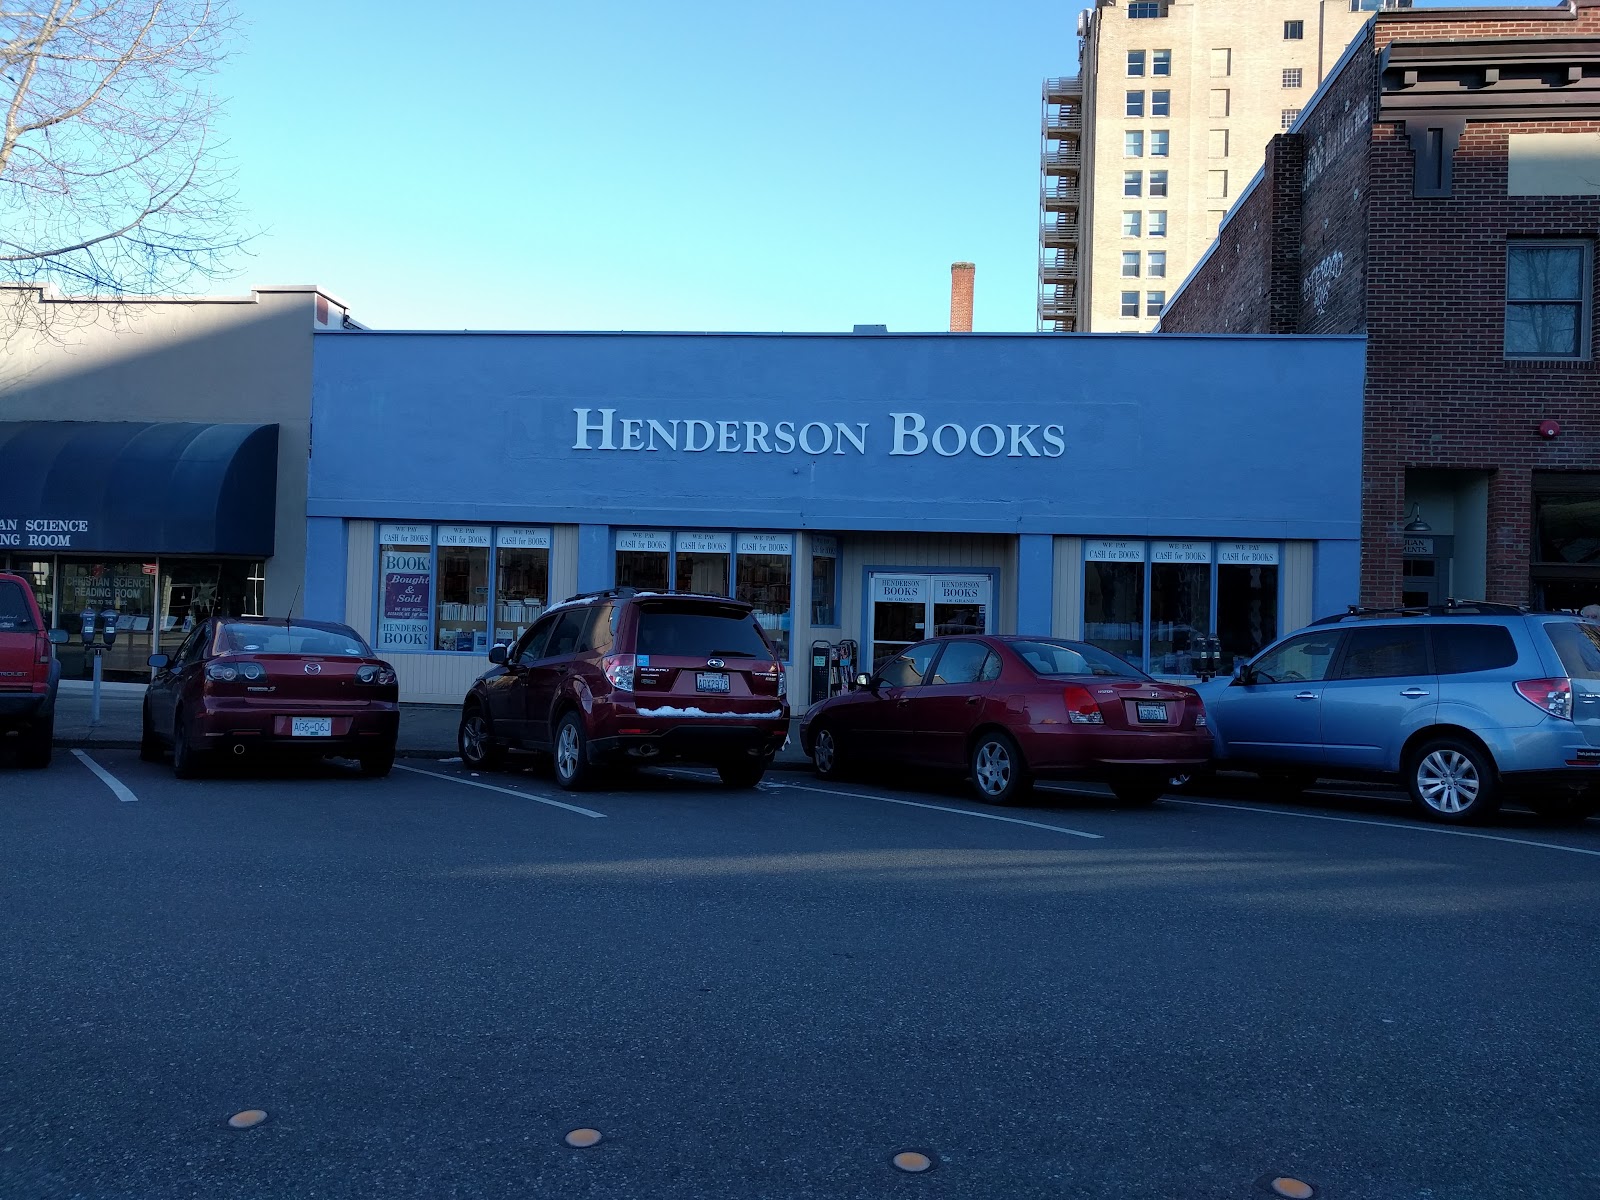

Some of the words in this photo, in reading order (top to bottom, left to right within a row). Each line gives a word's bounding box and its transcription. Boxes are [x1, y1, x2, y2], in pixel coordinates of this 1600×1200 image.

[572, 408, 870, 455] HENDERSON
[889, 412, 1065, 457] BOOKS
[26, 519, 88, 532] SCIENCE
[0, 533, 21, 546] NG
[28, 534, 71, 547] ROOM
[384, 534, 399, 542] CASH
[400, 534, 408, 542] for
[410, 535, 429, 543] BOOKS
[441, 535, 457, 544] CASH
[459, 535, 467, 544] for
[468, 536, 487, 544] BOOKS
[501, 536, 516, 545] CASH
[518, 536, 526, 545] for
[528, 537, 547, 545] BOOKS
[620, 540, 636, 549] CASH
[647, 540, 666, 549] BOOKS
[680, 541, 696, 550] CASH
[707, 542, 726, 550] BOOKS
[741, 542, 757, 551] CASH
[759, 542, 767, 551] for
[768, 543, 788, 552] BOOKS
[1089, 550, 1106, 559] CASH
[1108, 550, 1117, 559] for
[1119, 550, 1140, 559] BOOKS
[1155, 551, 1172, 561] CASH
[1174, 551, 1183, 561] for
[1185, 552, 1206, 561] BOOKS
[1222, 552, 1239, 562] CASH
[1241, 552, 1249, 562] for
[1252, 553, 1273, 562] BOOKS
[66, 576, 110, 587] CHRISTIAN
[113, 577, 150, 588] SCIENCE
[391, 575, 430, 585] Bought
[882, 579, 920, 587] HENDERSON
[75, 587, 111, 597] READING
[114, 588, 141, 599] ROOM
[405, 586, 414, 594] &
[884, 587, 918, 596] BOOKS
[943, 589, 978, 597] BOOKS
[397, 594, 422, 603] Sold
[383, 623, 428, 633] HENDERSO
